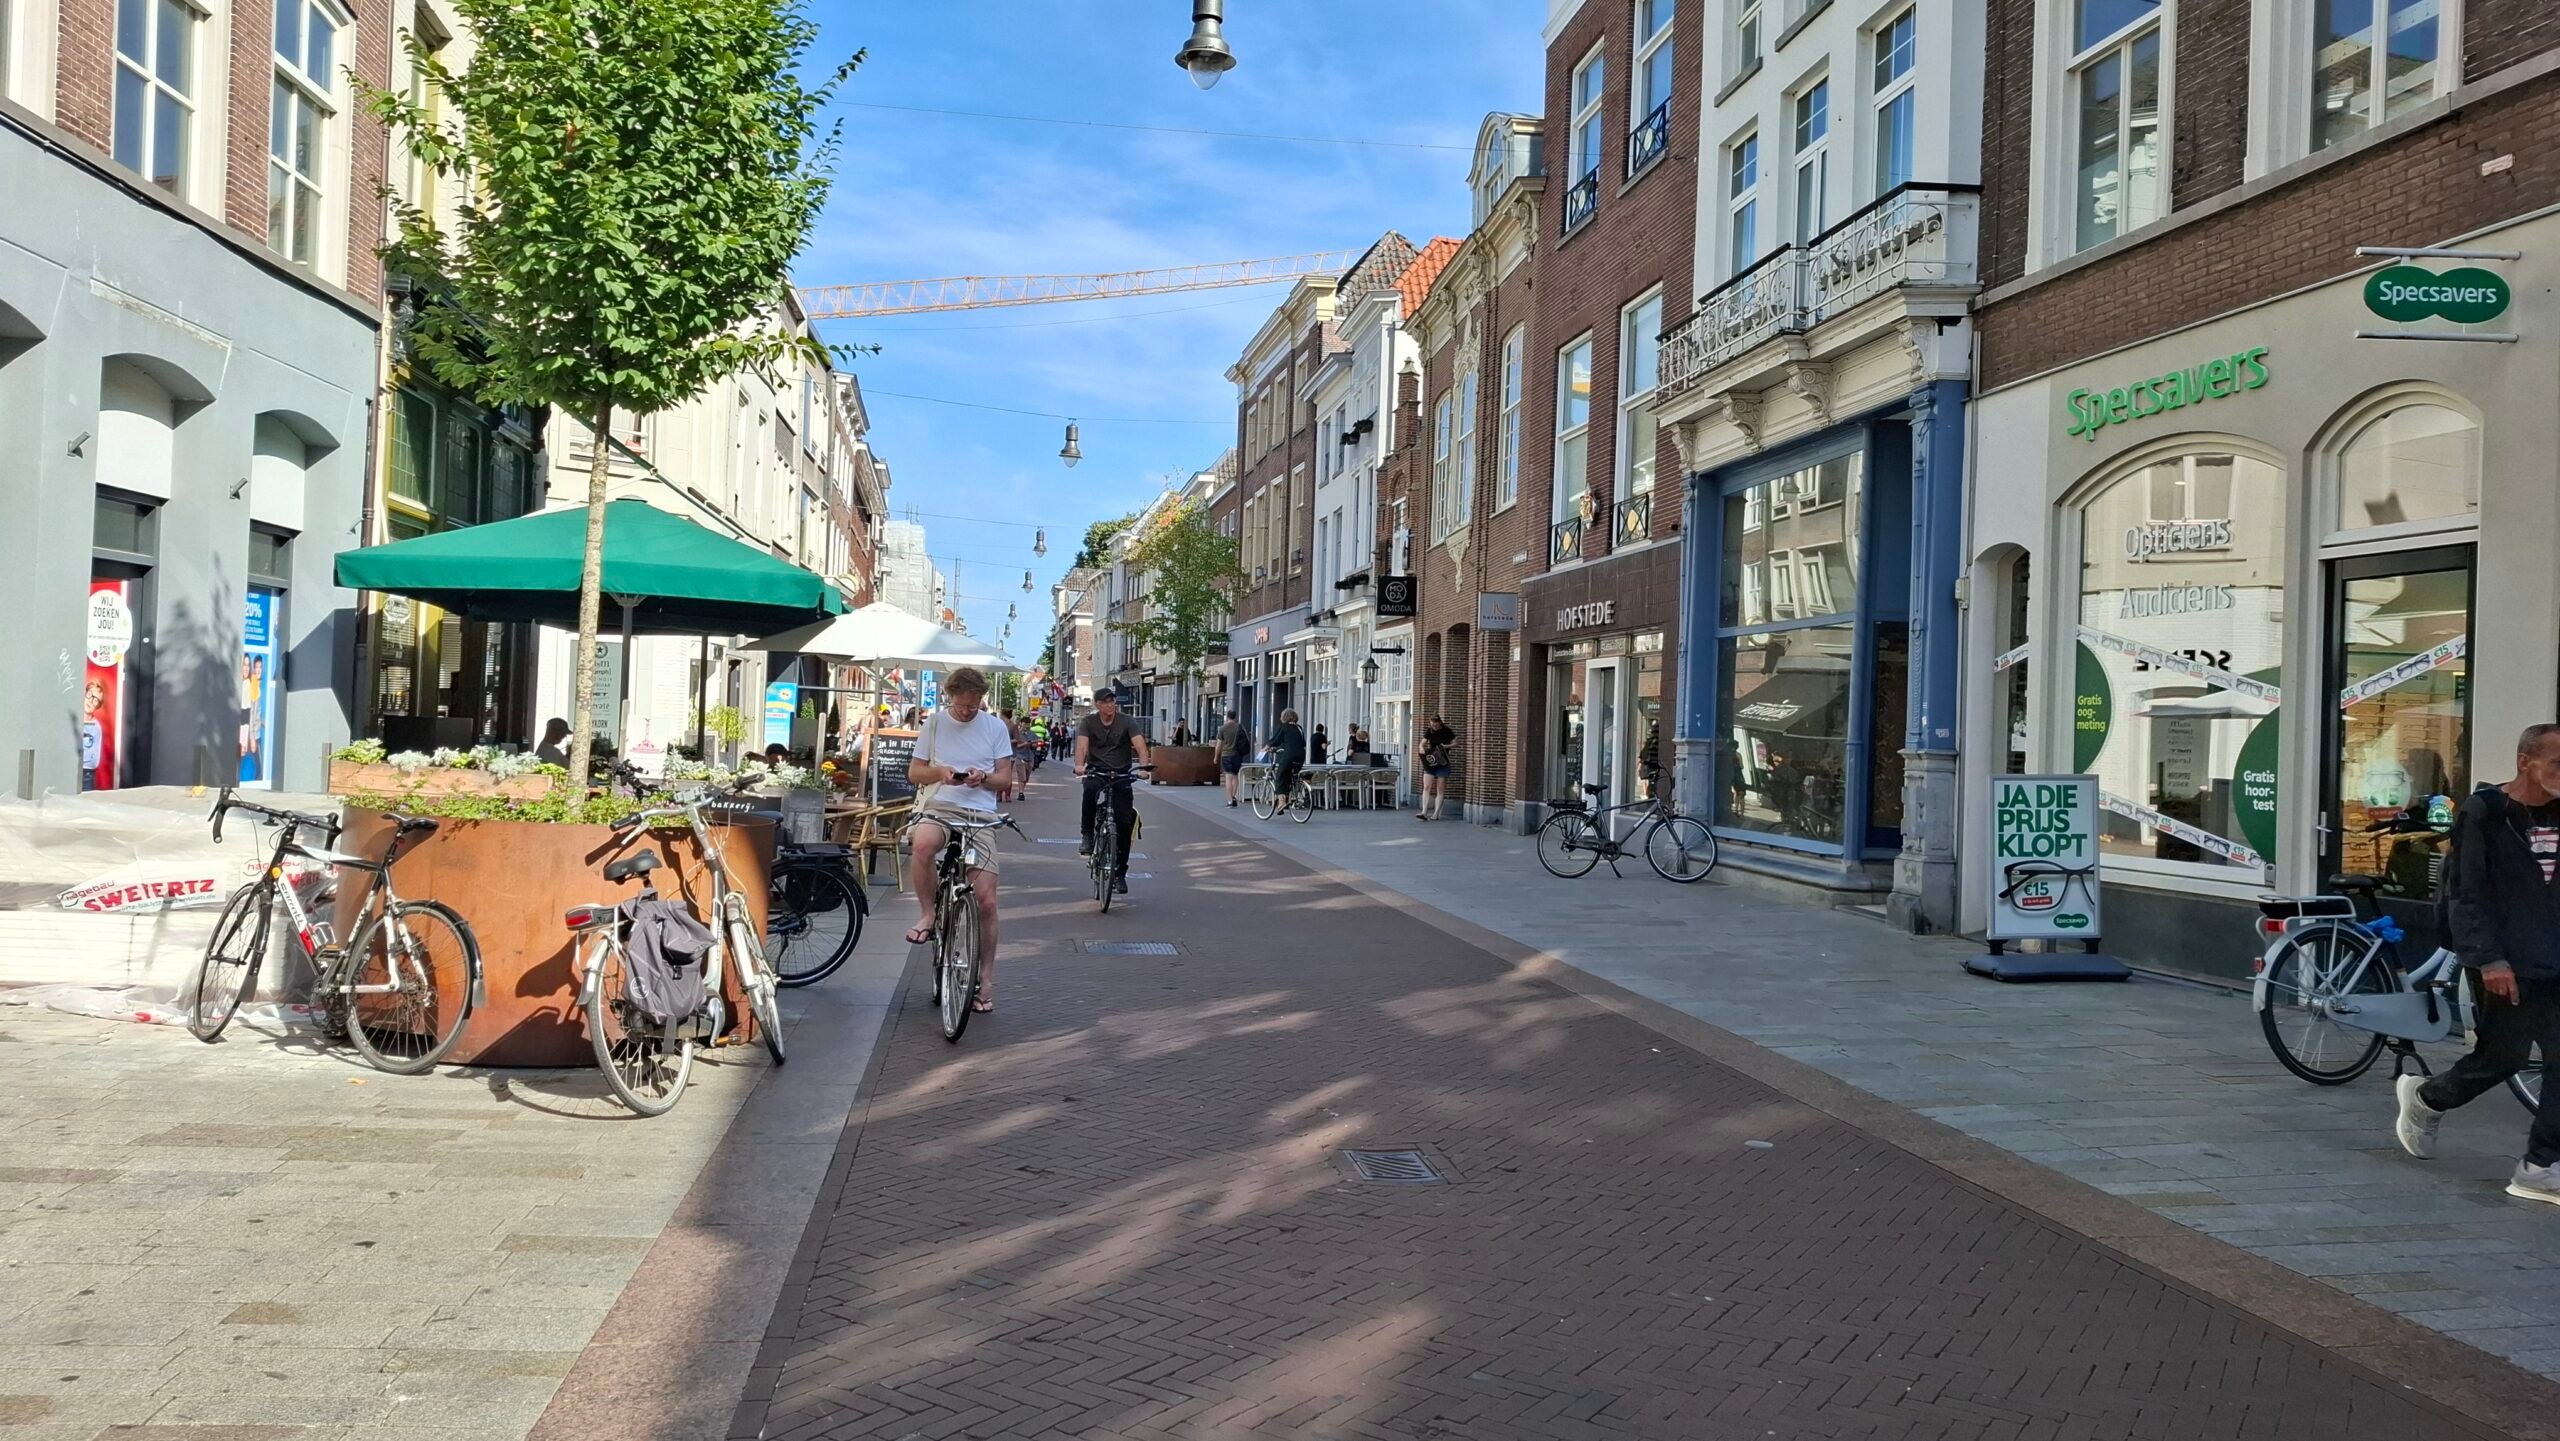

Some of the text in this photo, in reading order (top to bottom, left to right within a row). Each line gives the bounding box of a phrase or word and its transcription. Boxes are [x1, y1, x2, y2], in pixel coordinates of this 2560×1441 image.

[2379, 281, 2497, 305] Specsavers
[2067, 346, 2269, 442] Specsavers
[2125, 520, 2233, 563] Opticiens
[101, 596, 114, 606] WIJ
[2120, 583, 2235, 619] Audiciens
[93, 607, 120, 618] ZOEKEN
[1380, 604, 1412, 612] OMODA
[1557, 600, 1616, 631] HOFSTEDE
[98, 619, 115, 630] JOU!
[2077, 694, 2102, 705] Gratis
[2077, 709, 2097, 718] oog-
[2077, 718, 2106, 731] meting
[2243, 770, 2275, 783] Gratis
[1997, 784, 2078, 808] JA DIE
[2245, 784, 2275, 797] hoor-
[2253, 798, 2275, 811] test
[1998, 809, 2070, 833] PRIJS
[1998, 833, 2088, 857] KLOPT
[2023, 882, 2049, 896] €15
